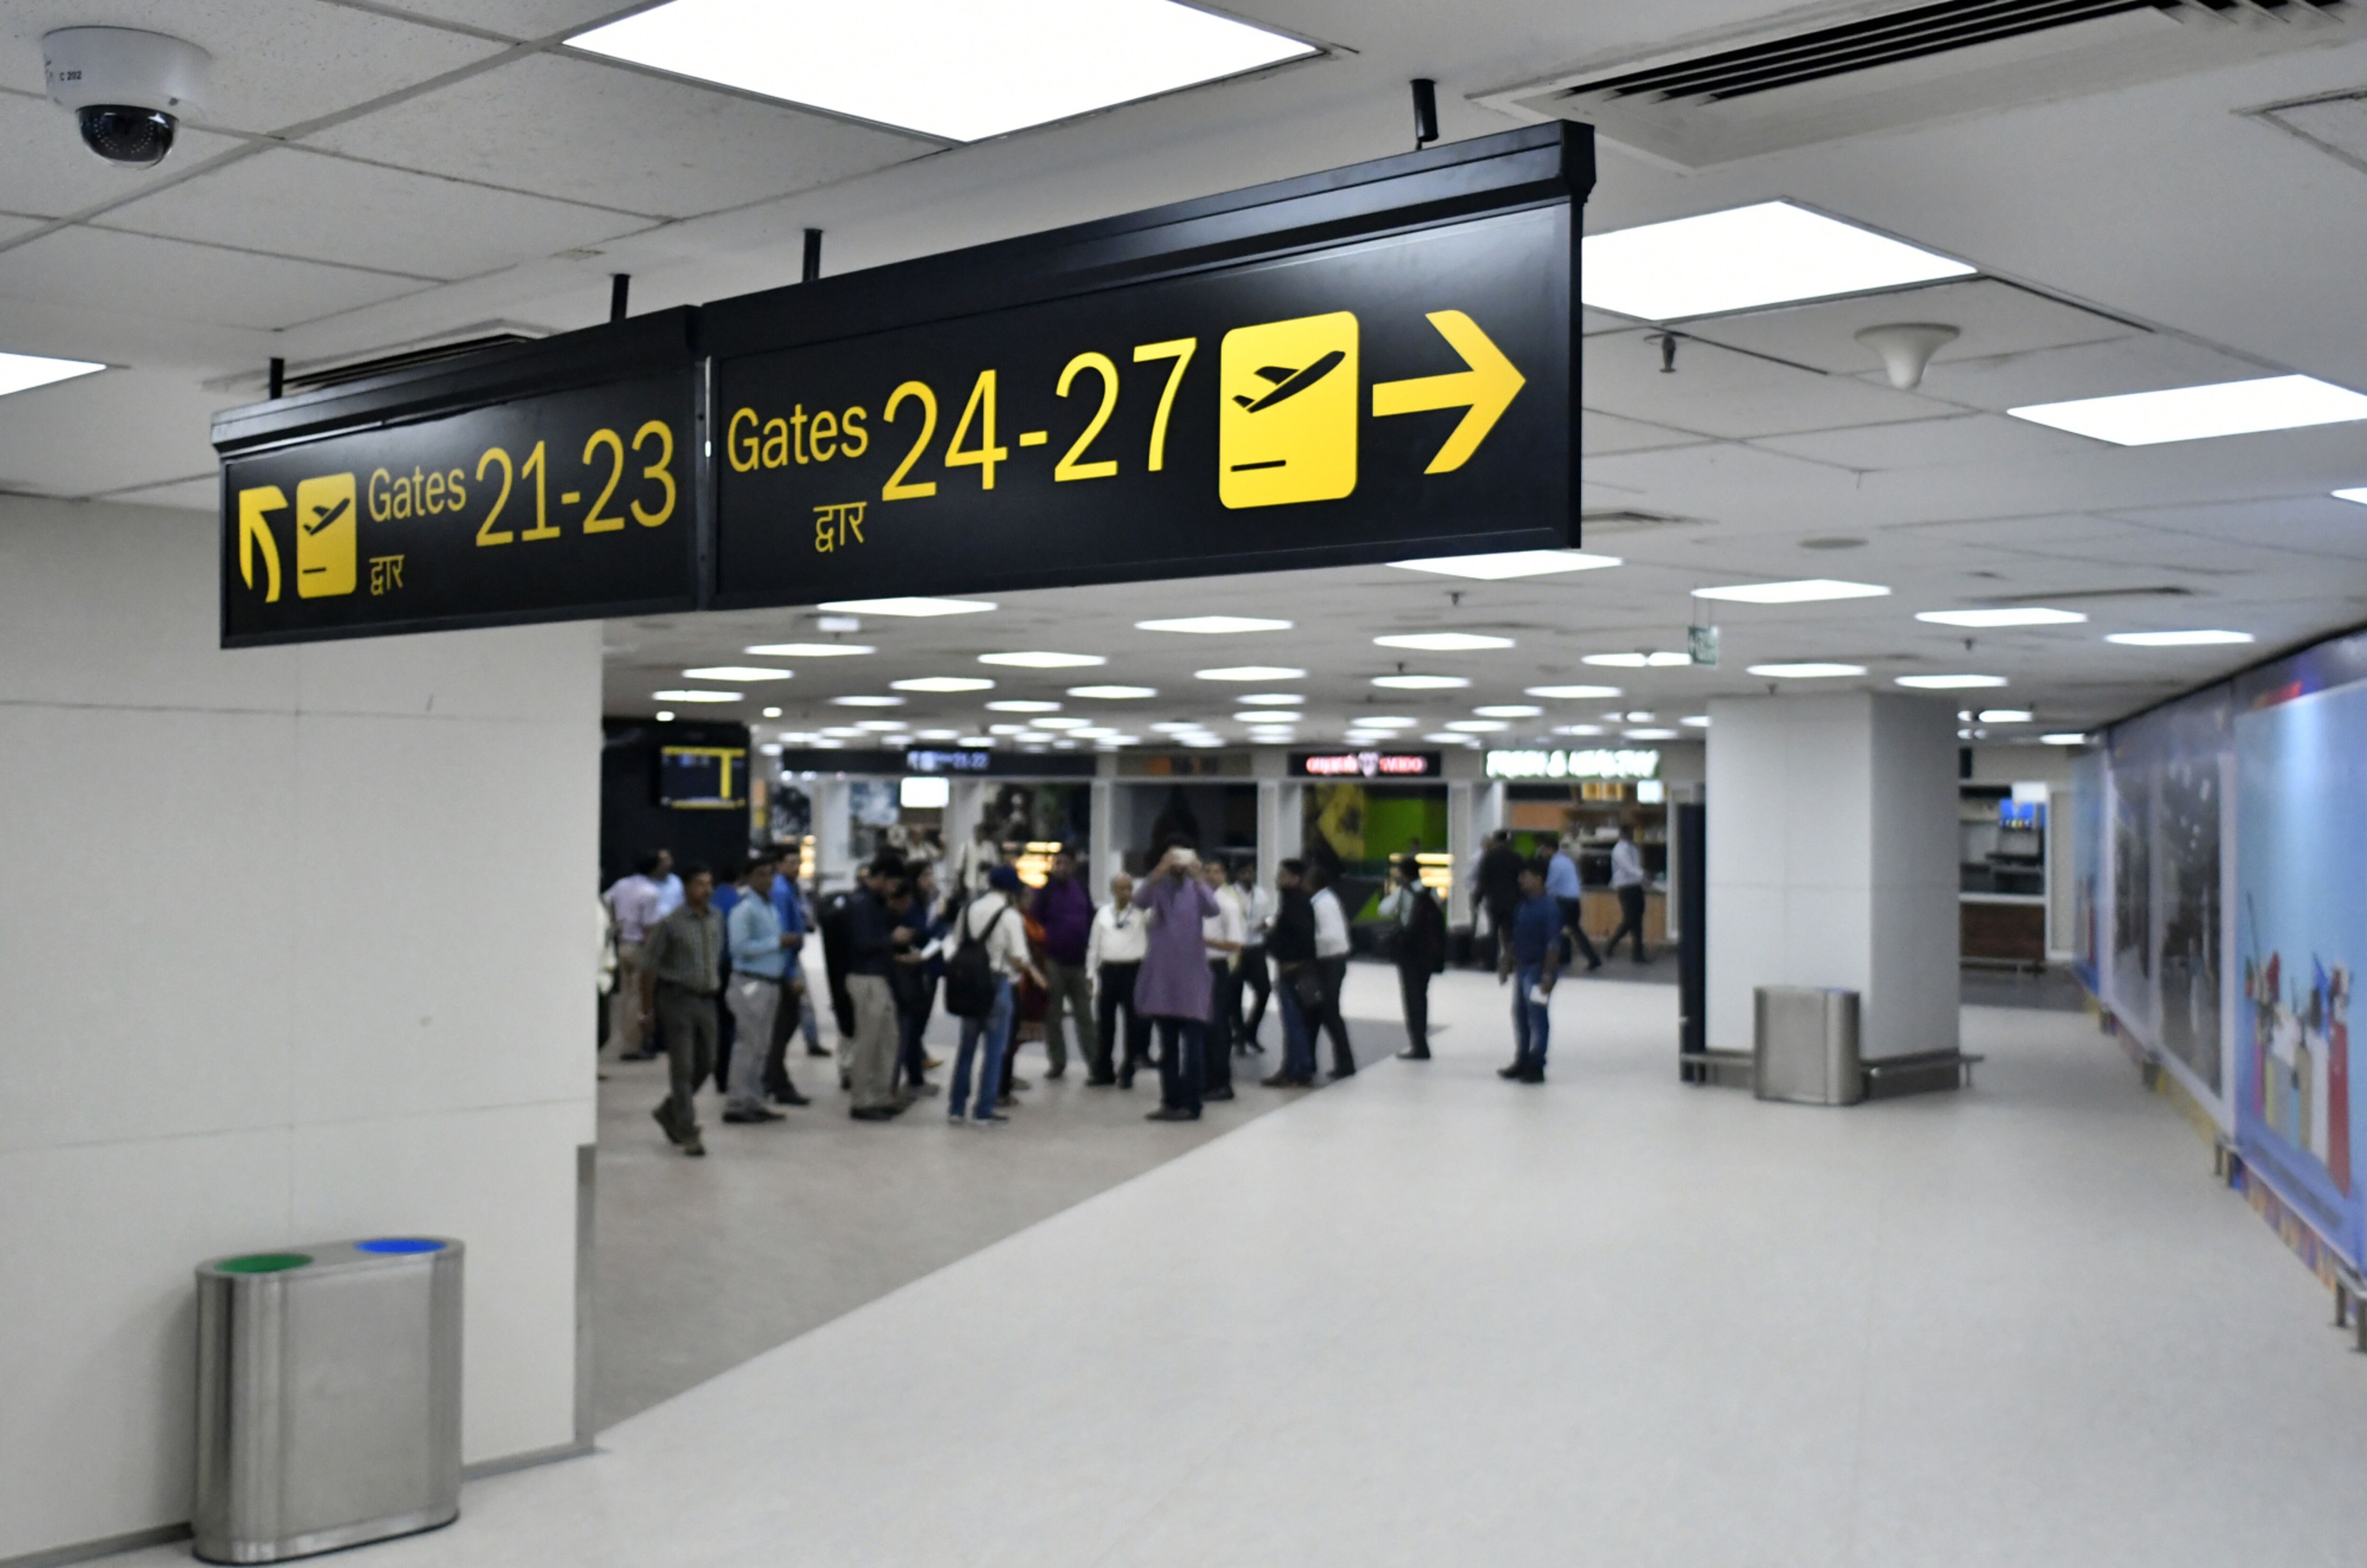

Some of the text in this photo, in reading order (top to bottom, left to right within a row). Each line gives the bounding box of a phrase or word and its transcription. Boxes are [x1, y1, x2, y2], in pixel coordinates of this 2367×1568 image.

[728, 337, 1197, 501] Gates 24-27
[368, 420, 676, 546] Gates 21-23
[813, 501, 867, 552] द्वार
[369, 554, 404, 595] द्वार
